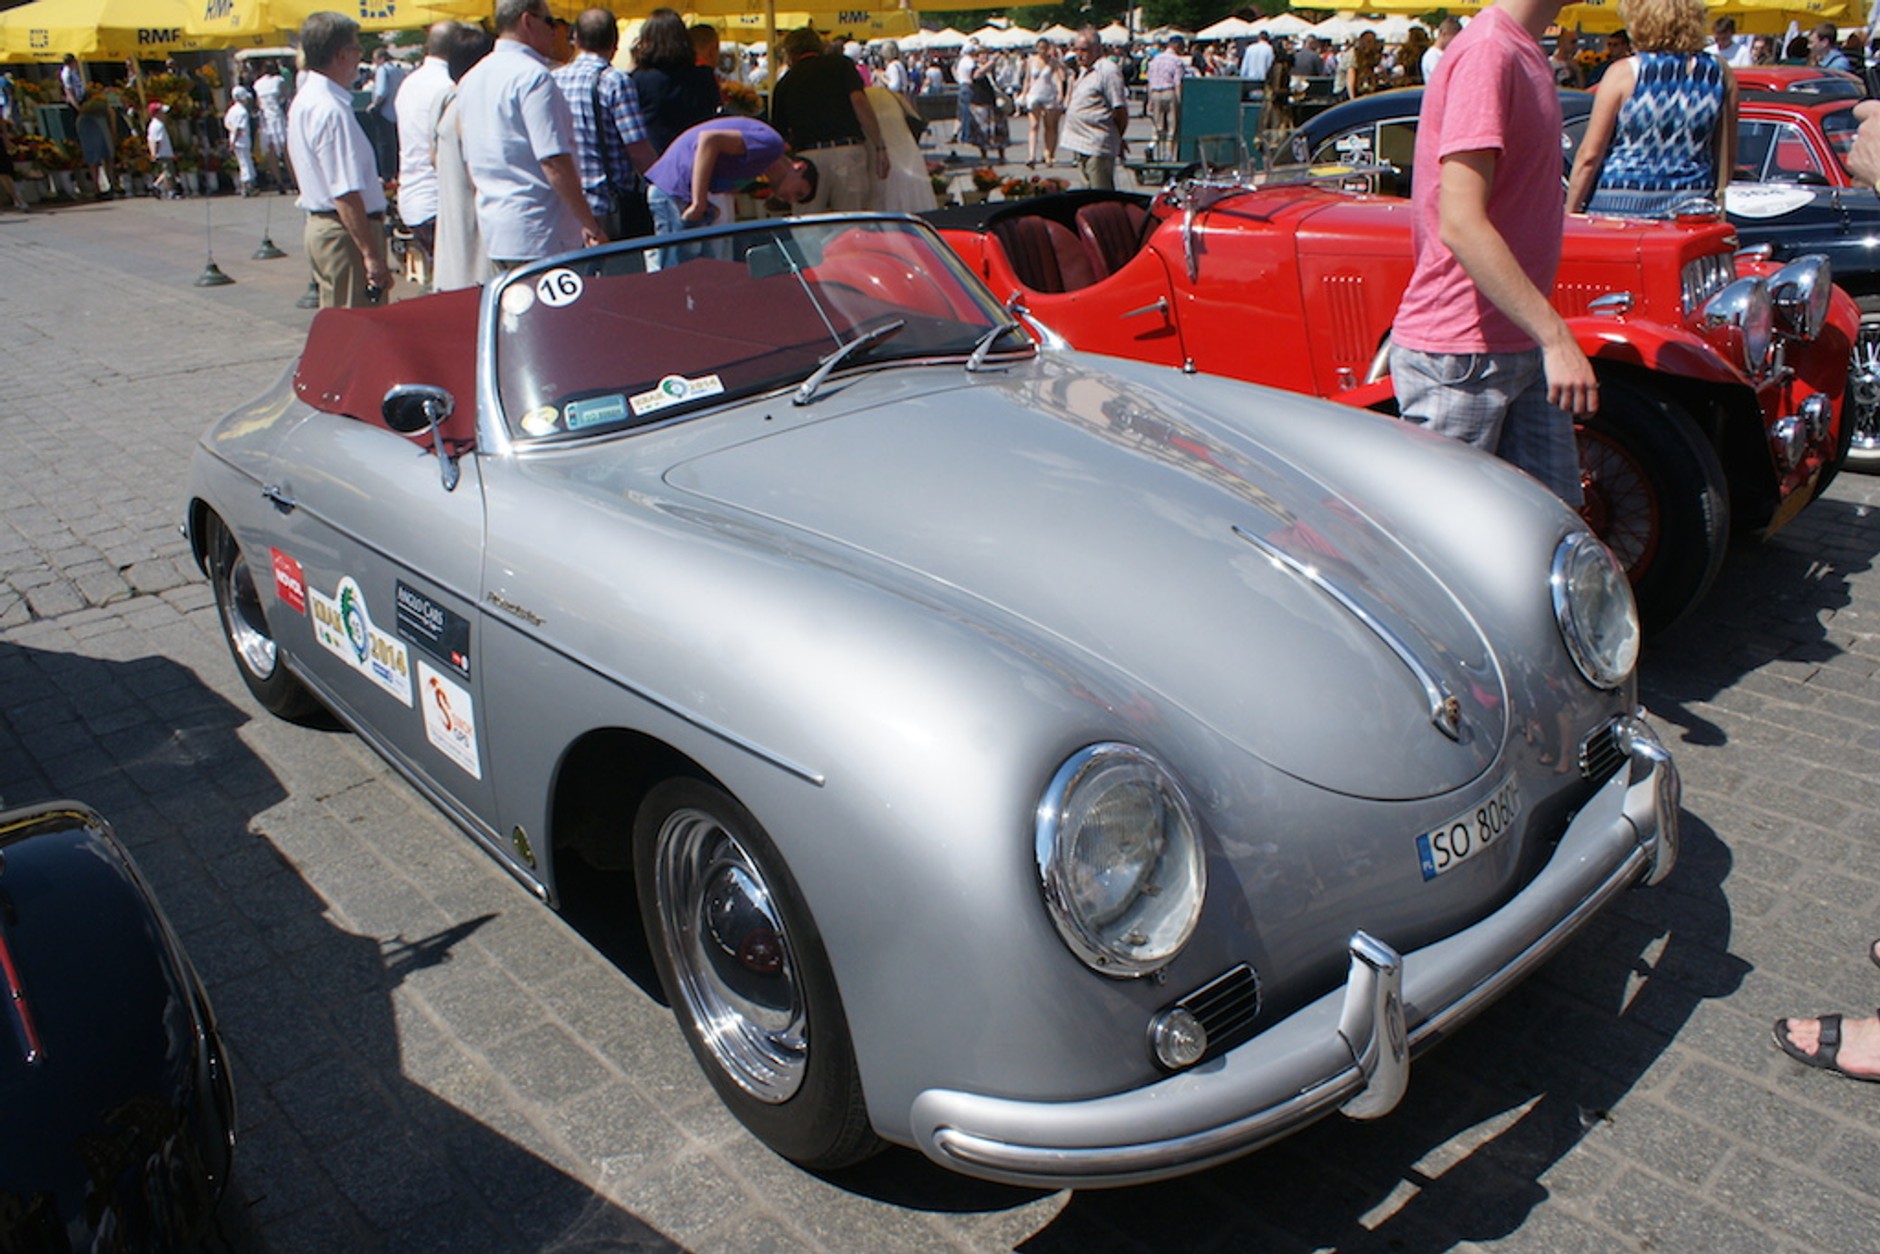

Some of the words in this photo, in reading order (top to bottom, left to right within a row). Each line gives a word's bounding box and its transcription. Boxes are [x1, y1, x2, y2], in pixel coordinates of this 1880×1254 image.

[838, 10, 871, 25] RMF
[137, 27, 181, 45] RMF
[540, 273, 578, 301] 16
[1433, 822, 1470, 868] SO
